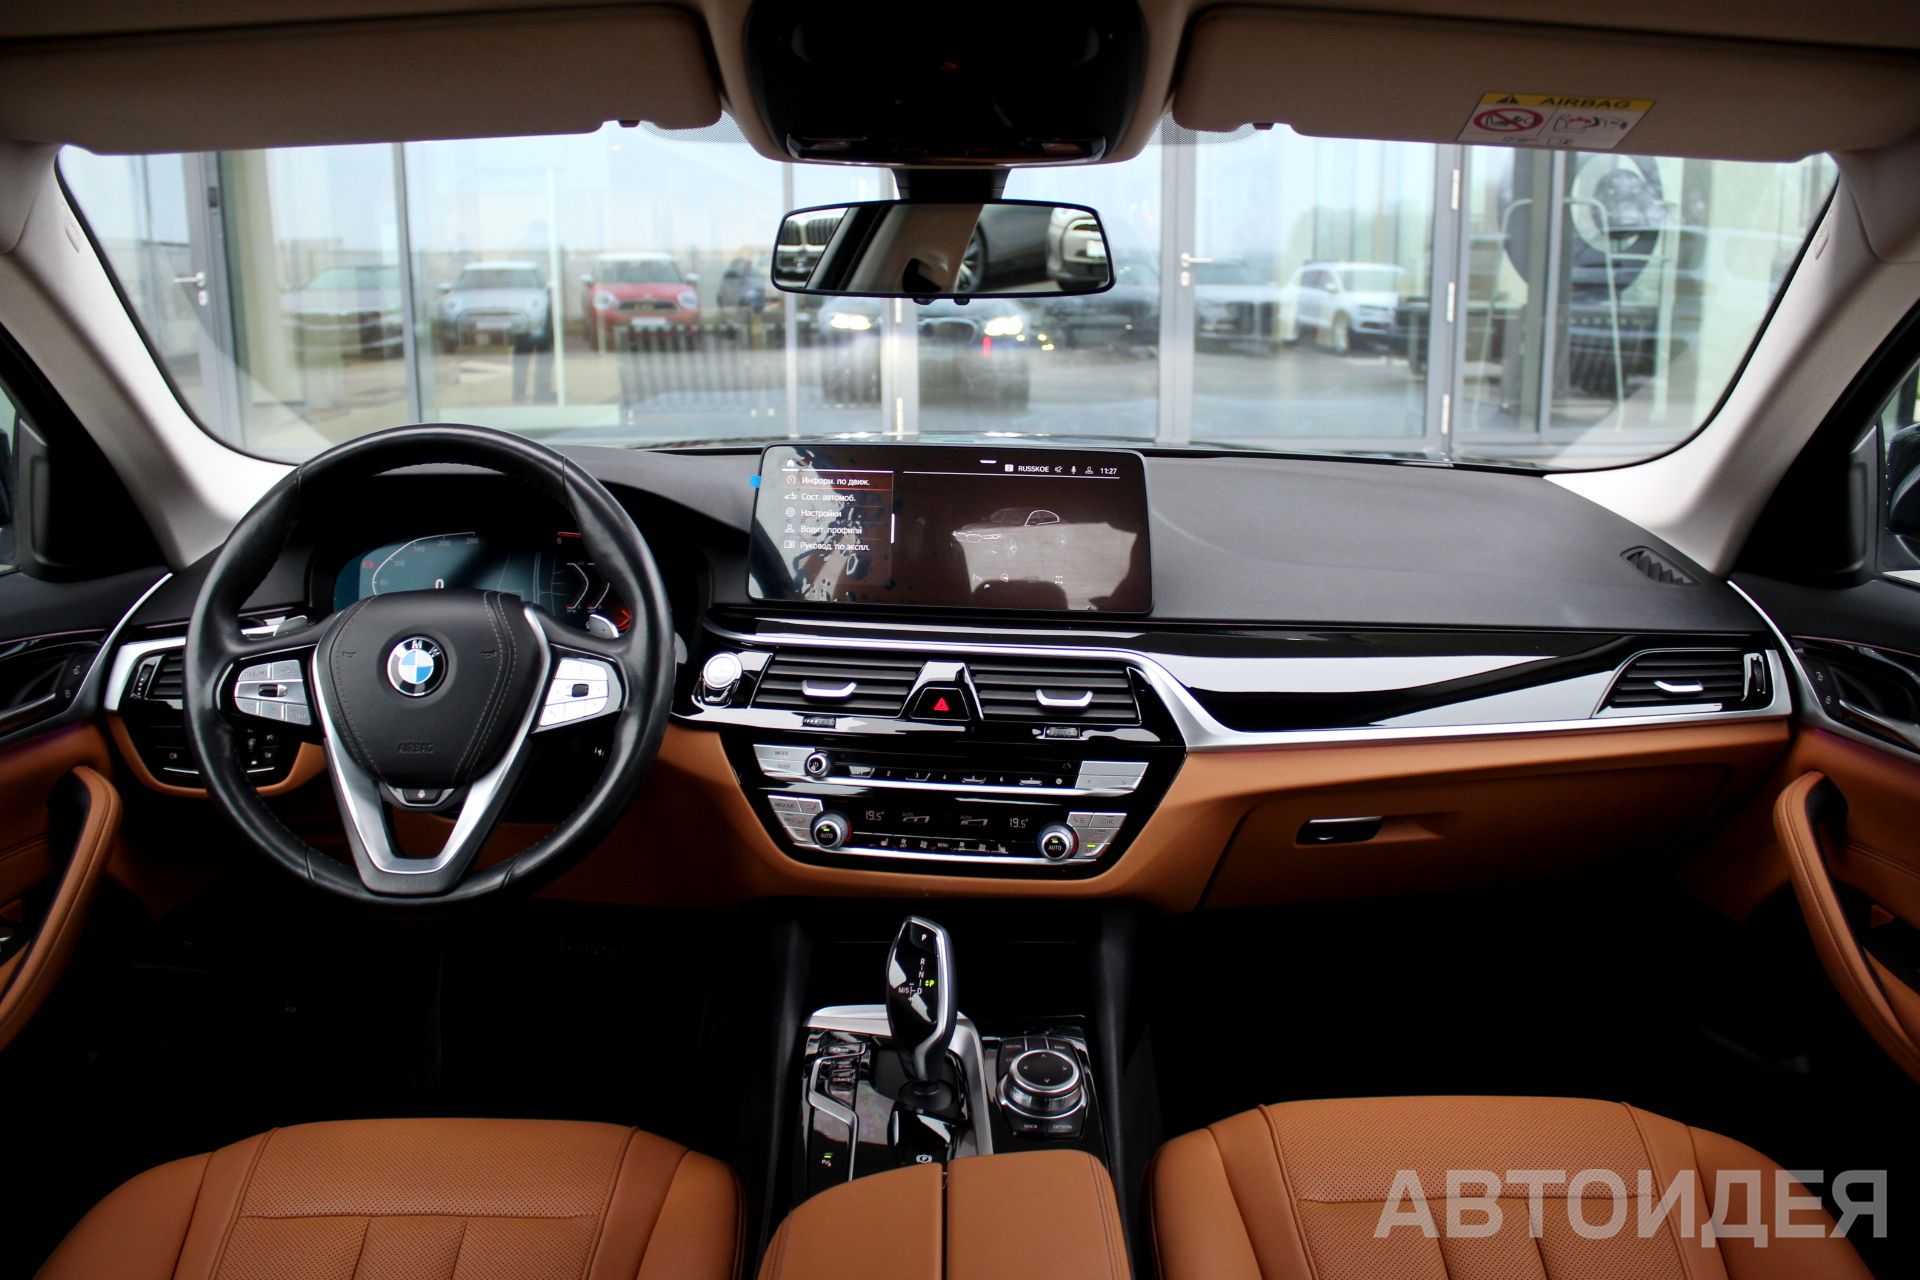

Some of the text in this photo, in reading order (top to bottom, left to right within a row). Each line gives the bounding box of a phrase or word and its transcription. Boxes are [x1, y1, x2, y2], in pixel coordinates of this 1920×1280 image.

[1539, 97, 1632, 109] AIRBAG
[1018, 465, 1049, 473] RUSSKOE
[1100, 467, 1117, 475] 11:27
[801, 477, 870, 487] Информ. по движ.
[801, 492, 856, 502] Сост. автомоб.
[801, 510, 842, 519] Настройки
[398, 742, 435, 754] AIRBAG
